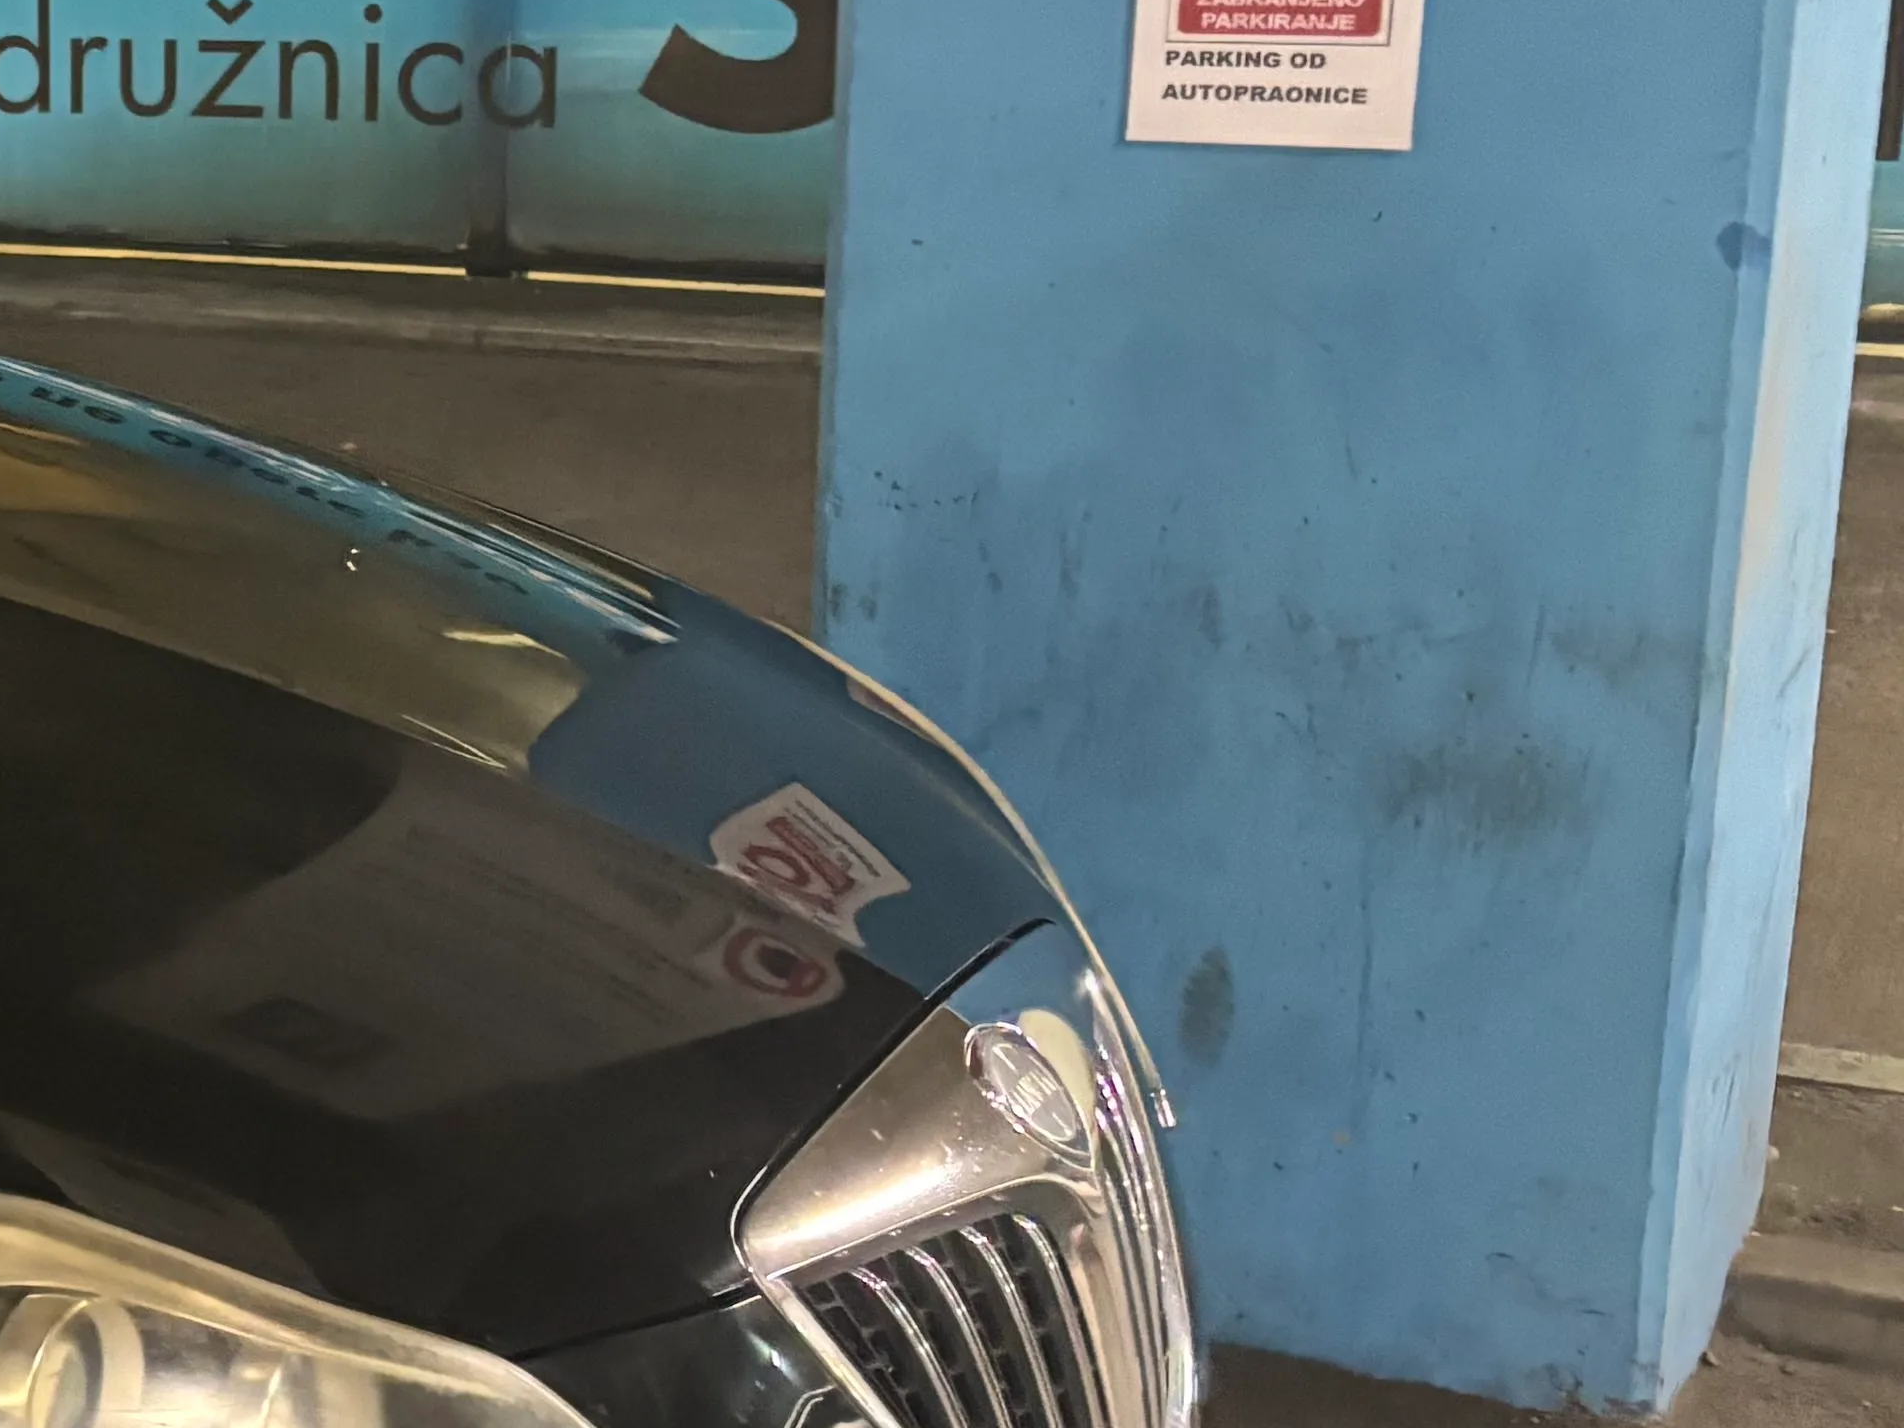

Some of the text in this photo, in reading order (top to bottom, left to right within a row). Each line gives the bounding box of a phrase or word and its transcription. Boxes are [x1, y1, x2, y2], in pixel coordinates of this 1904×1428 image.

[1200, 12, 1357, 31] PARKIRANJE
[1165, 49, 1327, 69] PARKING OD
[1161, 83, 1369, 105] AUTOPRAONICE
